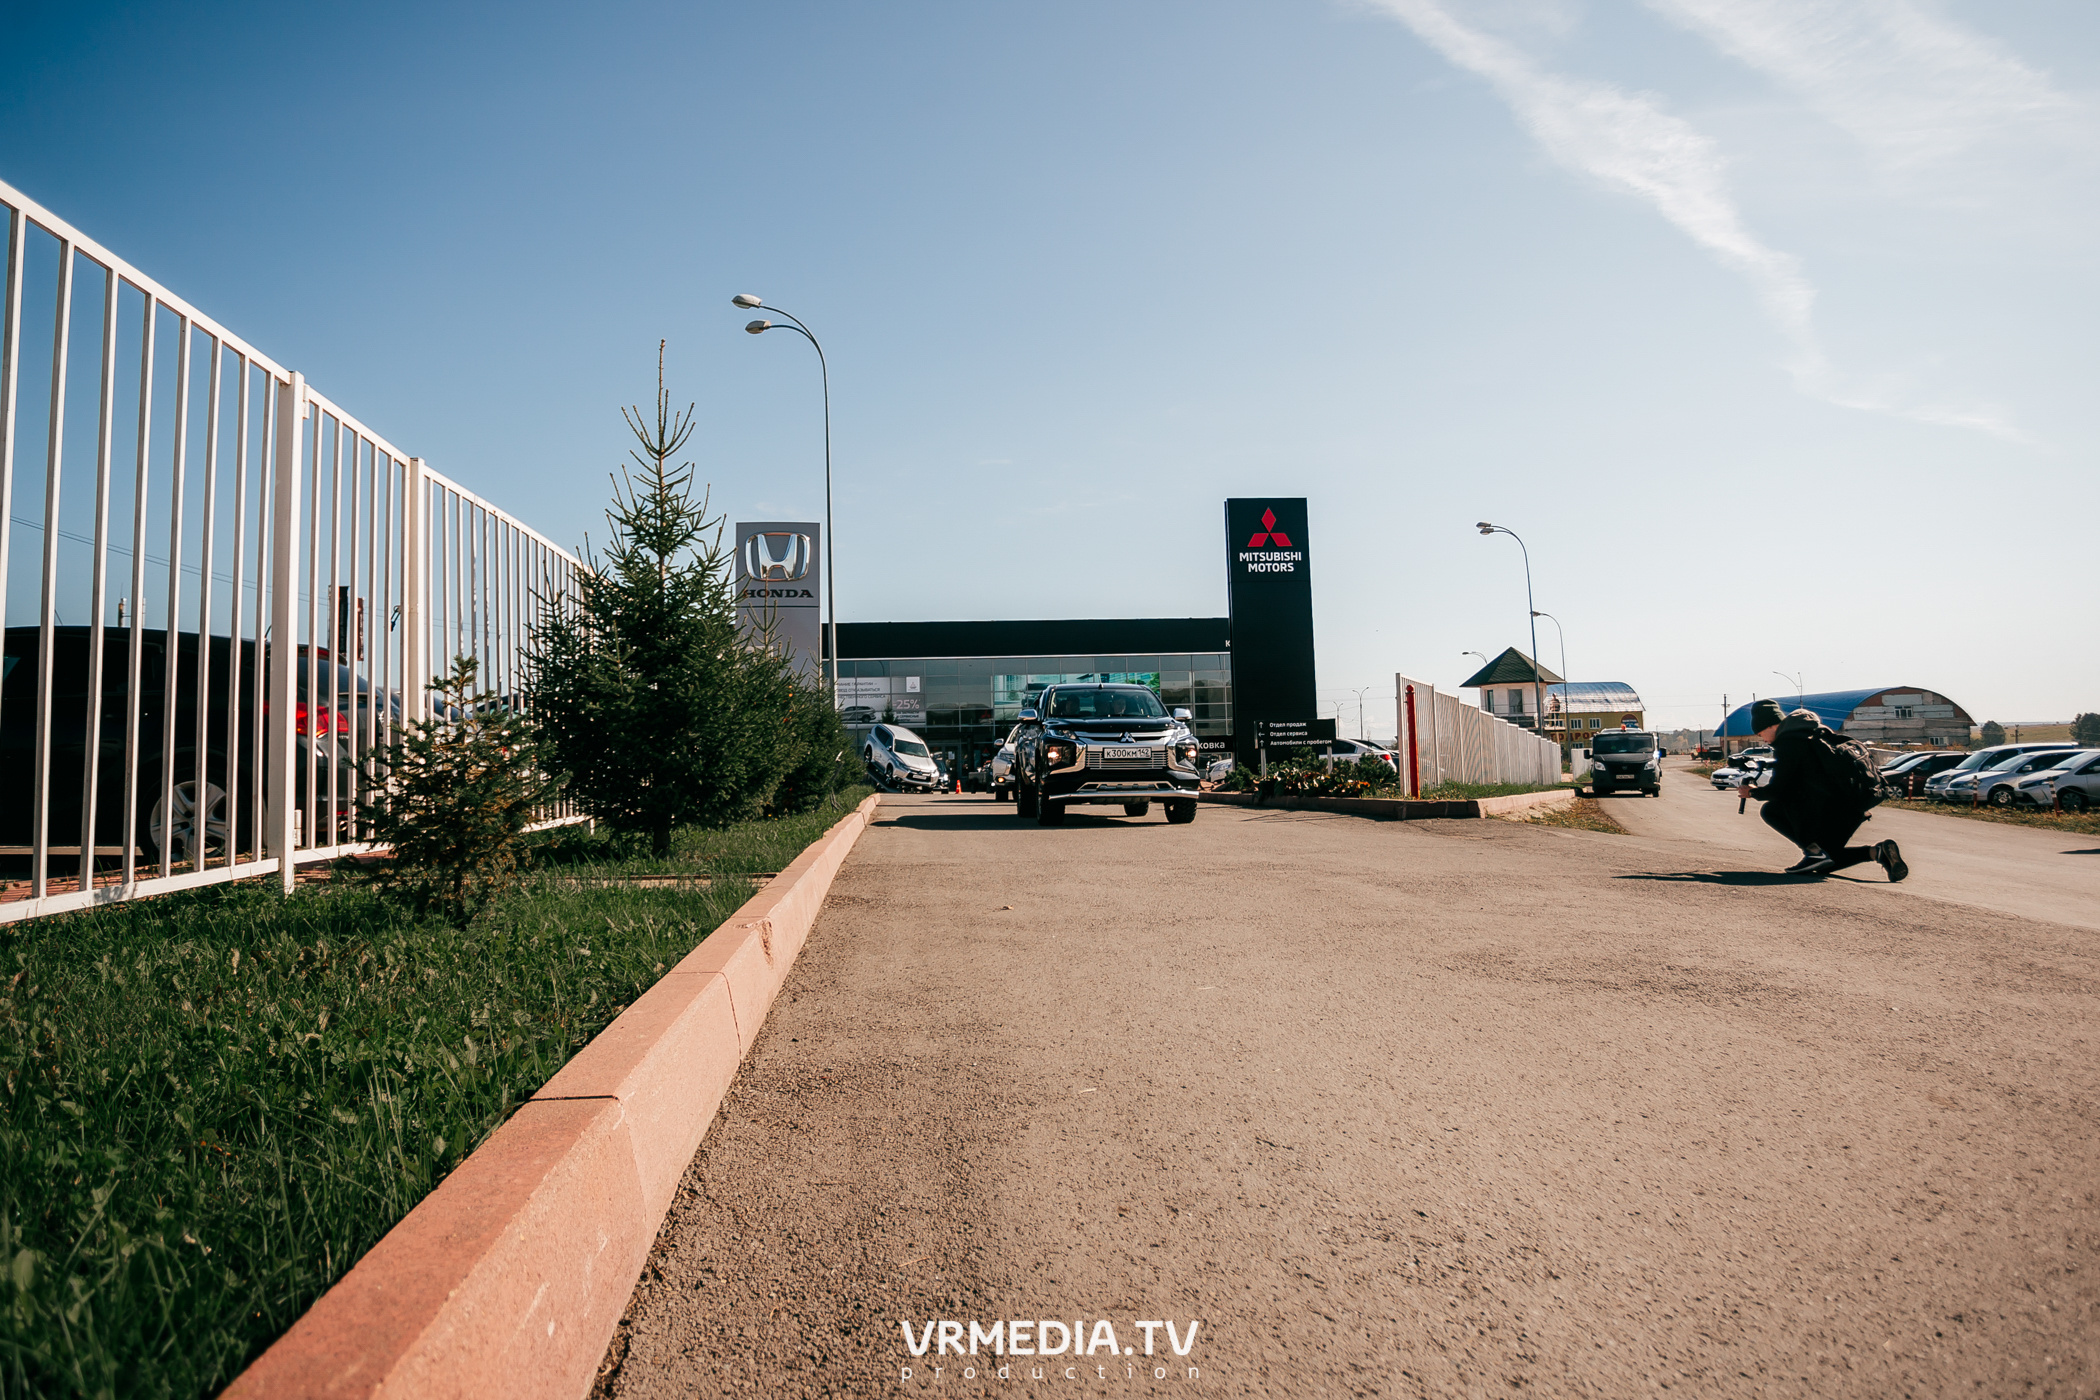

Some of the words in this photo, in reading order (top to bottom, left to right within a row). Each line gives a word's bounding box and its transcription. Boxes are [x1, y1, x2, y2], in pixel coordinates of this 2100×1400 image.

[1239, 552, 1302, 562] MITSUBISHI
[1248, 562, 1294, 573] MOTORS
[744, 589, 814, 598] HONDA
